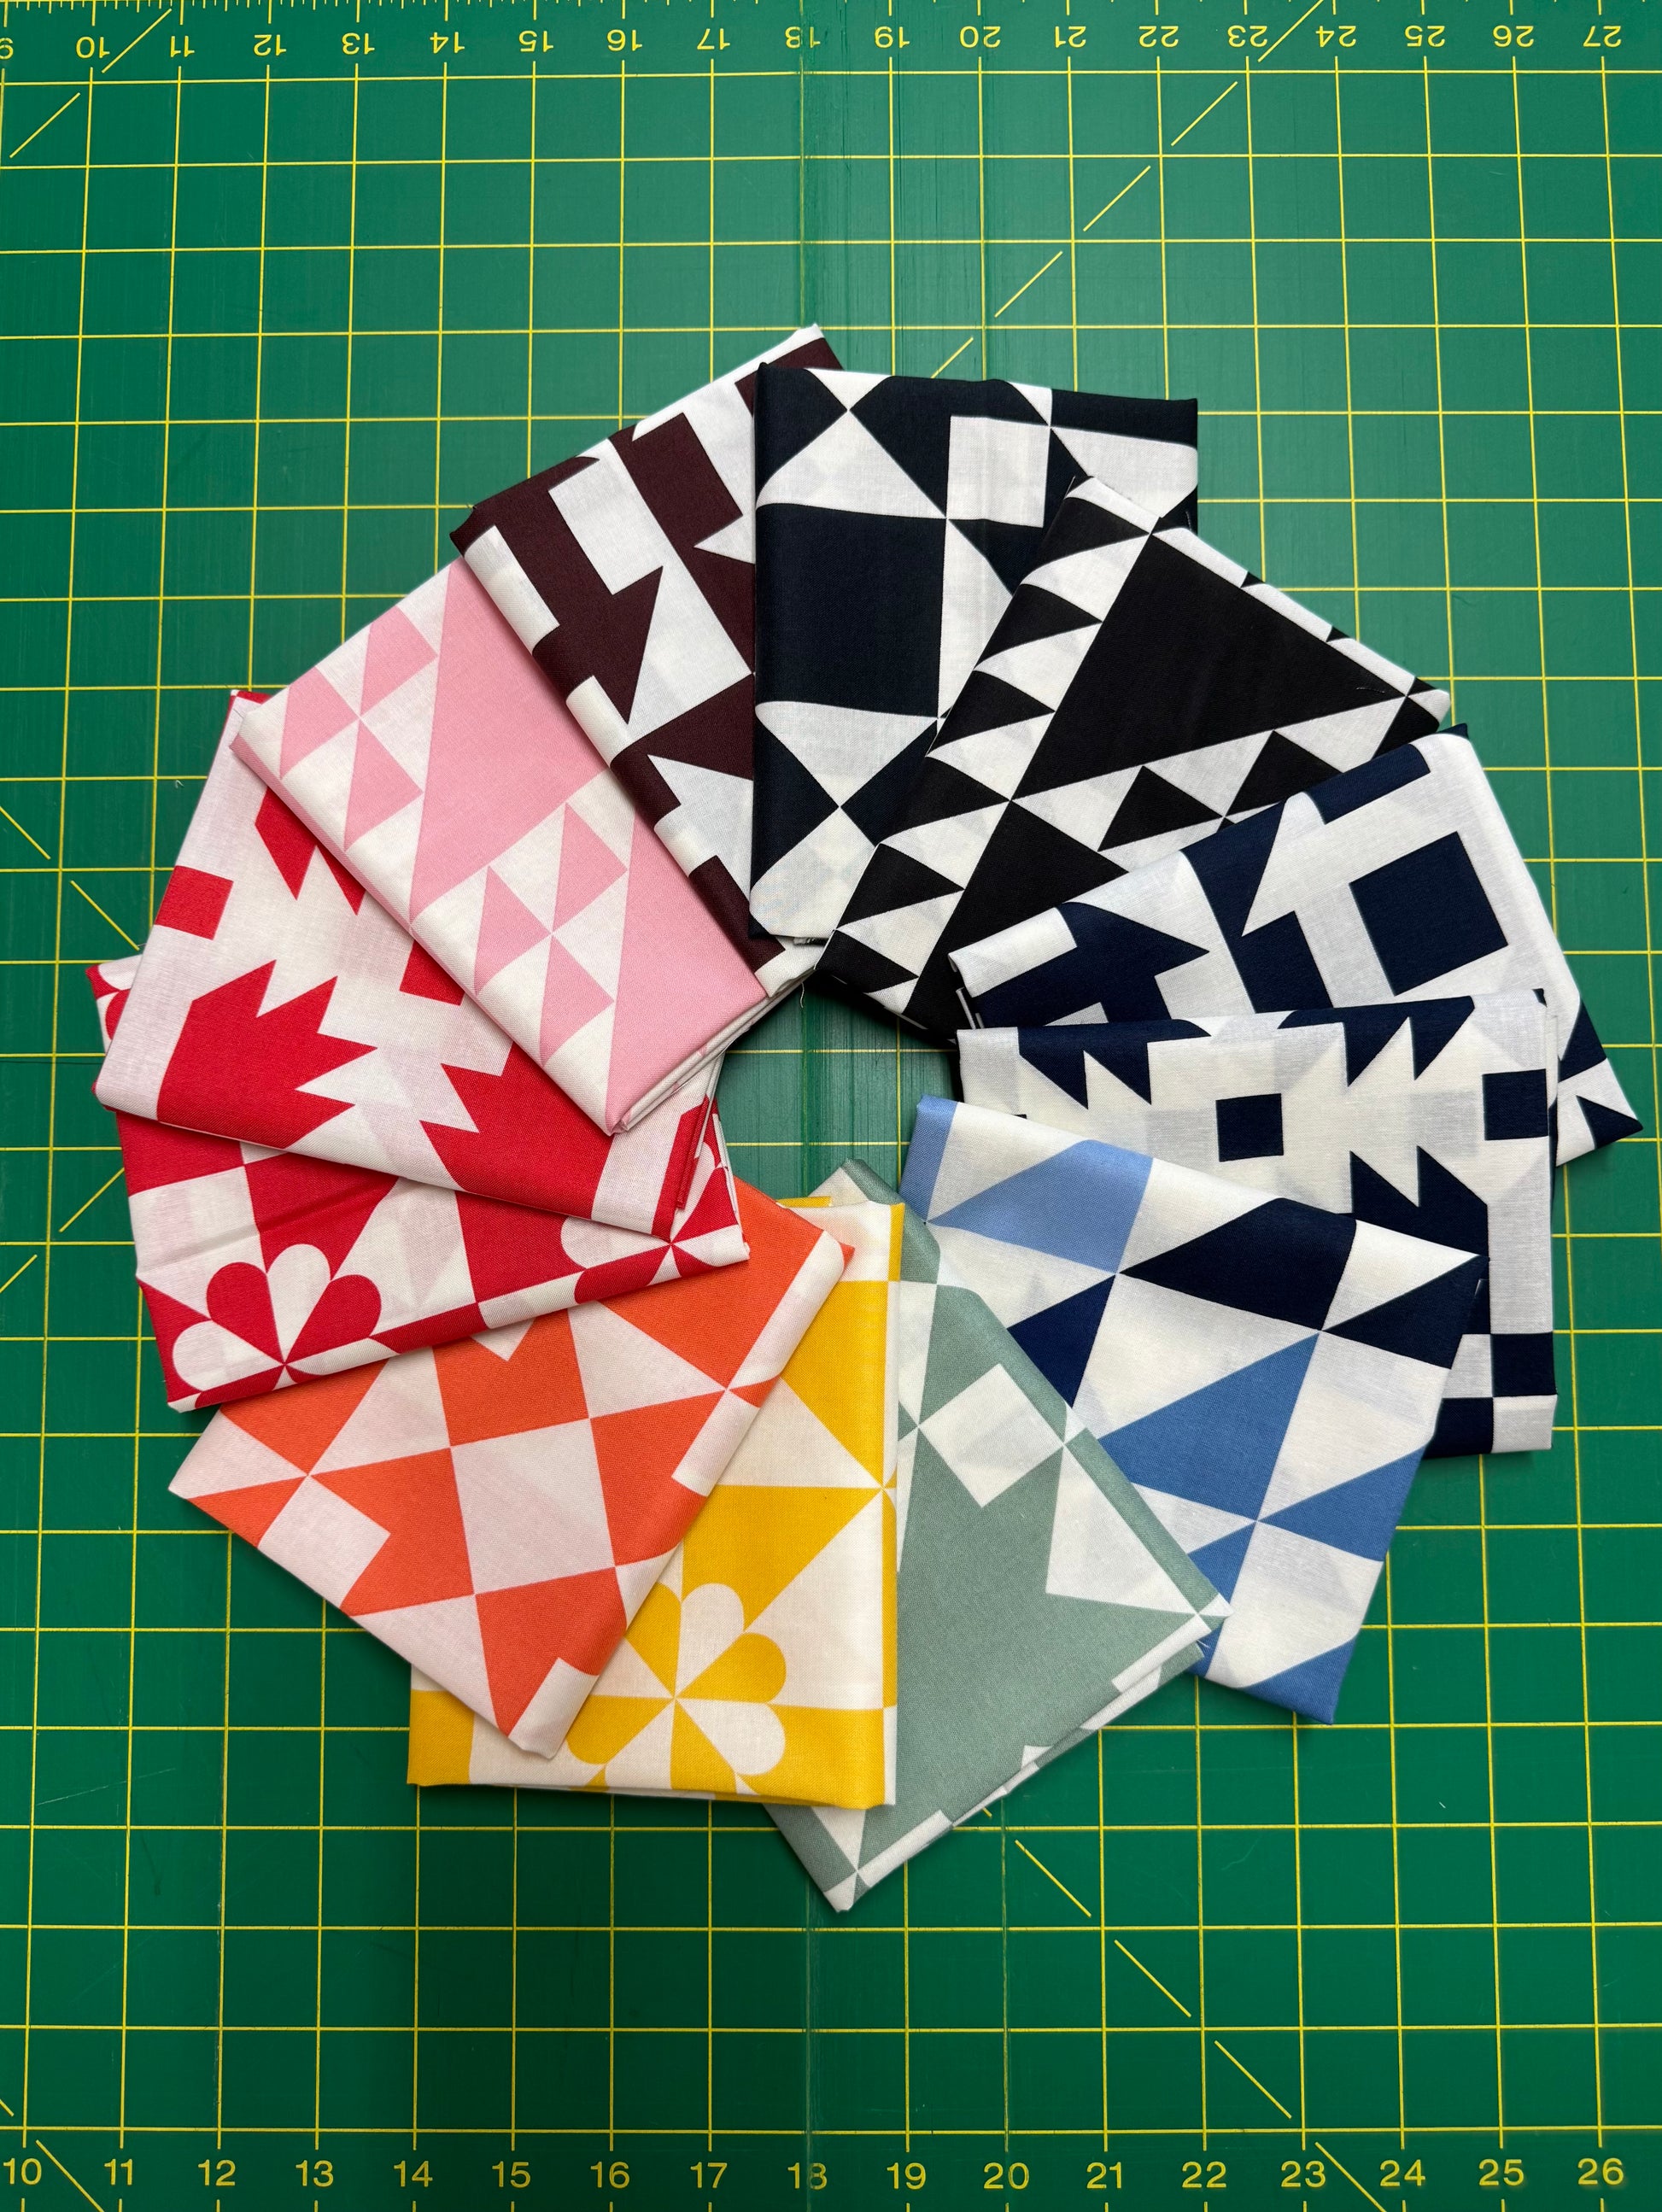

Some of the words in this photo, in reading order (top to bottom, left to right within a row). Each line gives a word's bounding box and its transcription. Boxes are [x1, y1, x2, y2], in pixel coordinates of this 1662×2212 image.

[76, 36, 110, 59] 10
[170, 35, 195, 58] 11
[254, 34, 287, 56] 12
[342, 32, 375, 56] 13
[430, 32, 465, 54] 14
[518, 30, 554, 52] 15
[606, 29, 643, 52] 16
[696, 28, 731, 51] 17
[784, 26, 821, 49] 18
[874, 26, 910, 49] 19
[959, 26, 1001, 49] 20
[1054, 26, 1087, 49] 21
[1138, 25, 1179, 48] 22
[1227, 25, 1269, 48] 23
[1315, 26, 1357, 48] 24
[1404, 25, 1446, 48] 25
[1493, 25, 1534, 48] 26
[1583, 26, 1622, 48] 27
[3, 2157, 42, 2186] 10
[103, 2158, 133, 2186] 11
[197, 2159, 236, 2187] 12
[296, 2159, 334, 2187] 13
[394, 2160, 434, 2187] 14
[492, 2160, 531, 2188] 15
[590, 2161, 630, 2189] 16
[690, 2161, 729, 2188] 17
[787, 2162, 828, 2190] 18
[887, 2162, 927, 2190] 19
[983, 2162, 1029, 2190] 20
[1086, 2162, 1122, 2189] 21
[1181, 2161, 1227, 2188] 22
[1280, 2160, 1326, 2188] 23
[1379, 2159, 1426, 2187] 24
[1478, 2158, 1524, 2186] 25
[1577, 2157, 1624, 2186] 26
